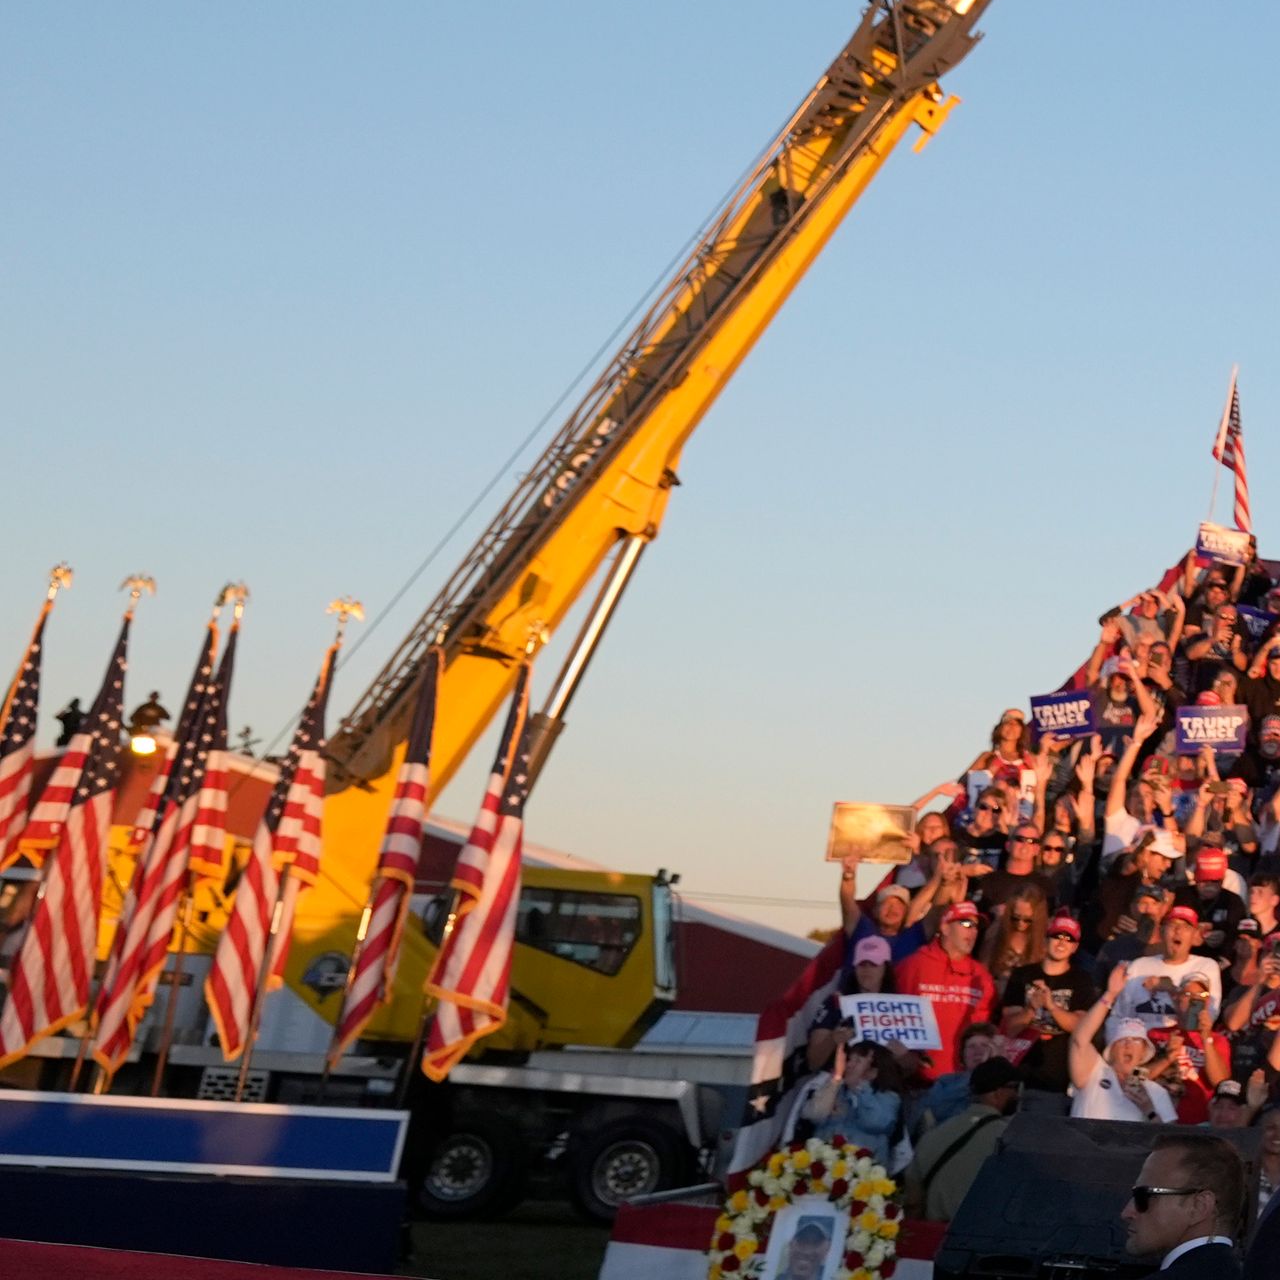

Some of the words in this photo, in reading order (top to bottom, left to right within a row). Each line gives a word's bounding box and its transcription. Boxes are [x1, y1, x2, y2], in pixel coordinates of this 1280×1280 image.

[1033, 699, 1091, 719] TRUMP
[1038, 712, 1087, 727] VANCE
[1180, 716, 1243, 730] TRUMP
[1185, 728, 1236, 739] VANCE
[857, 1001, 921, 1014] FIGHT!
[860, 1015, 925, 1028] FIGHT!
[862, 1028, 928, 1041] FIGHT!
